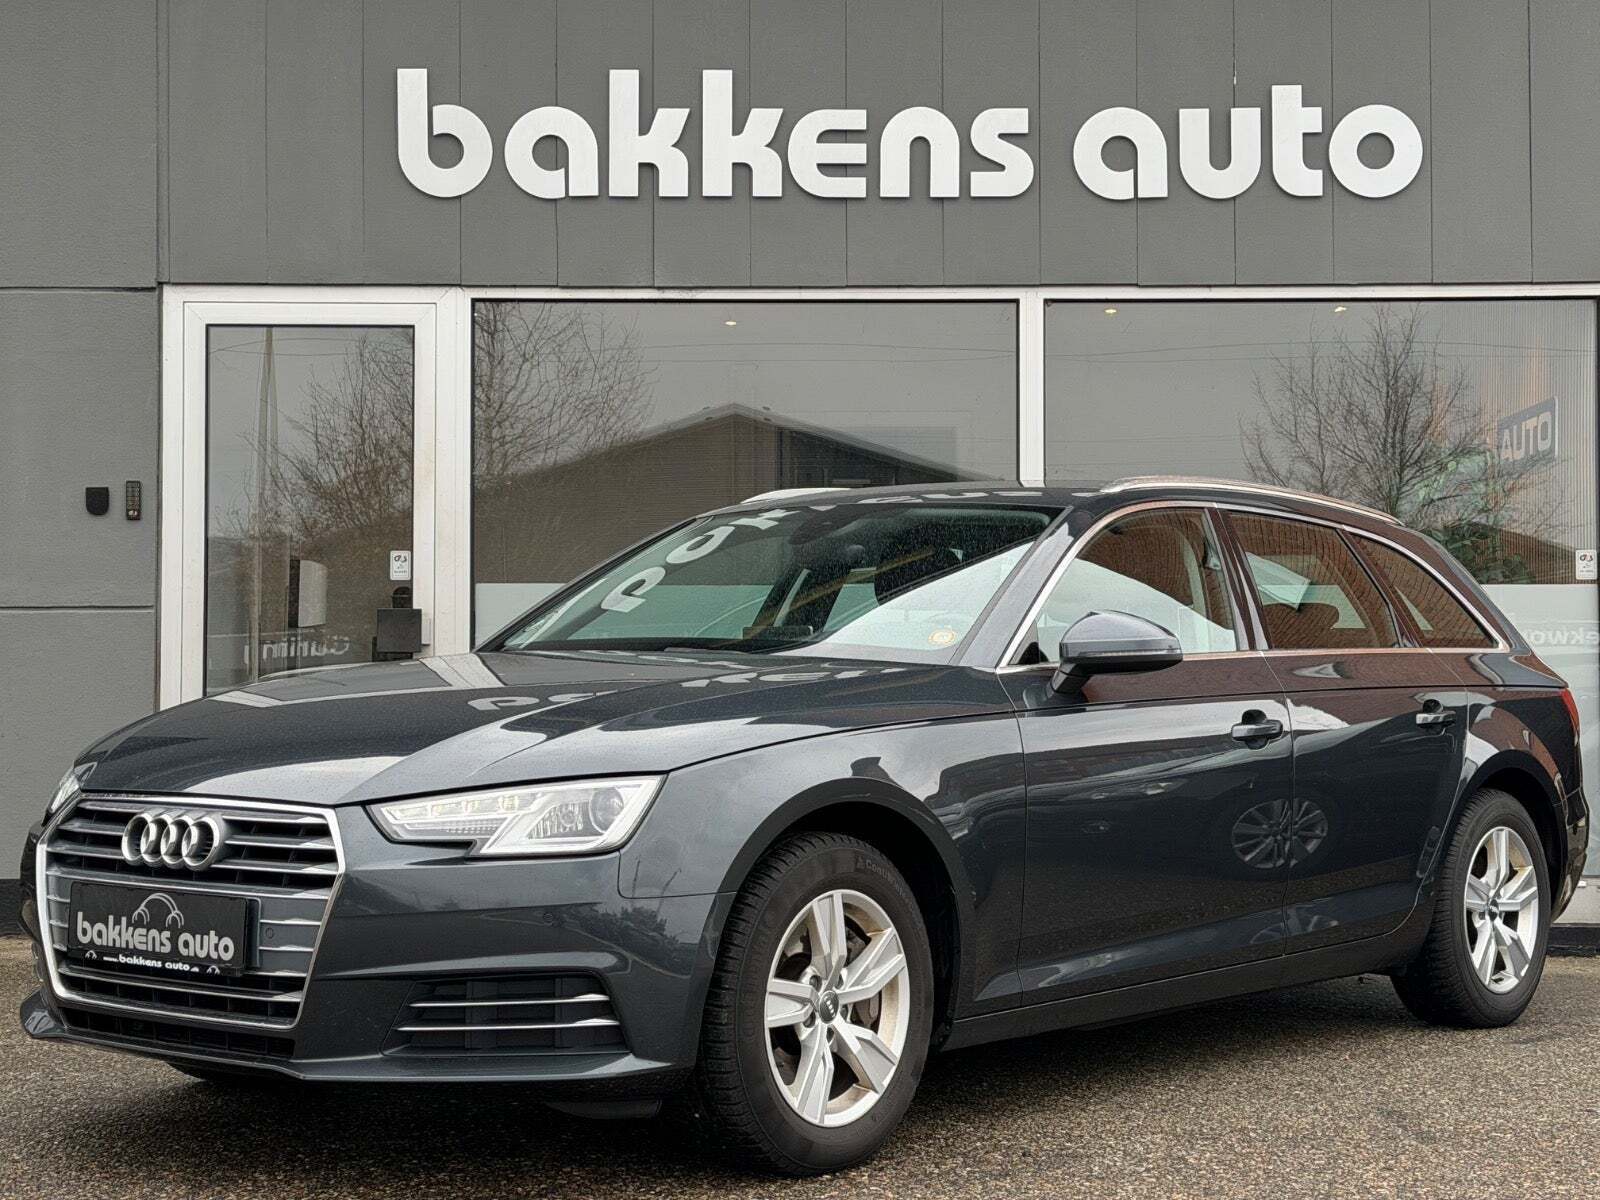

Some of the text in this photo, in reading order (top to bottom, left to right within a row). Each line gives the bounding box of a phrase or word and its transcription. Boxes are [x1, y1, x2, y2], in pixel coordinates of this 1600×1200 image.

[396, 68, 1424, 200] bakkens auto
[1500, 411, 1552, 461] AUTO
[78, 911, 235, 962] bakkens auto
